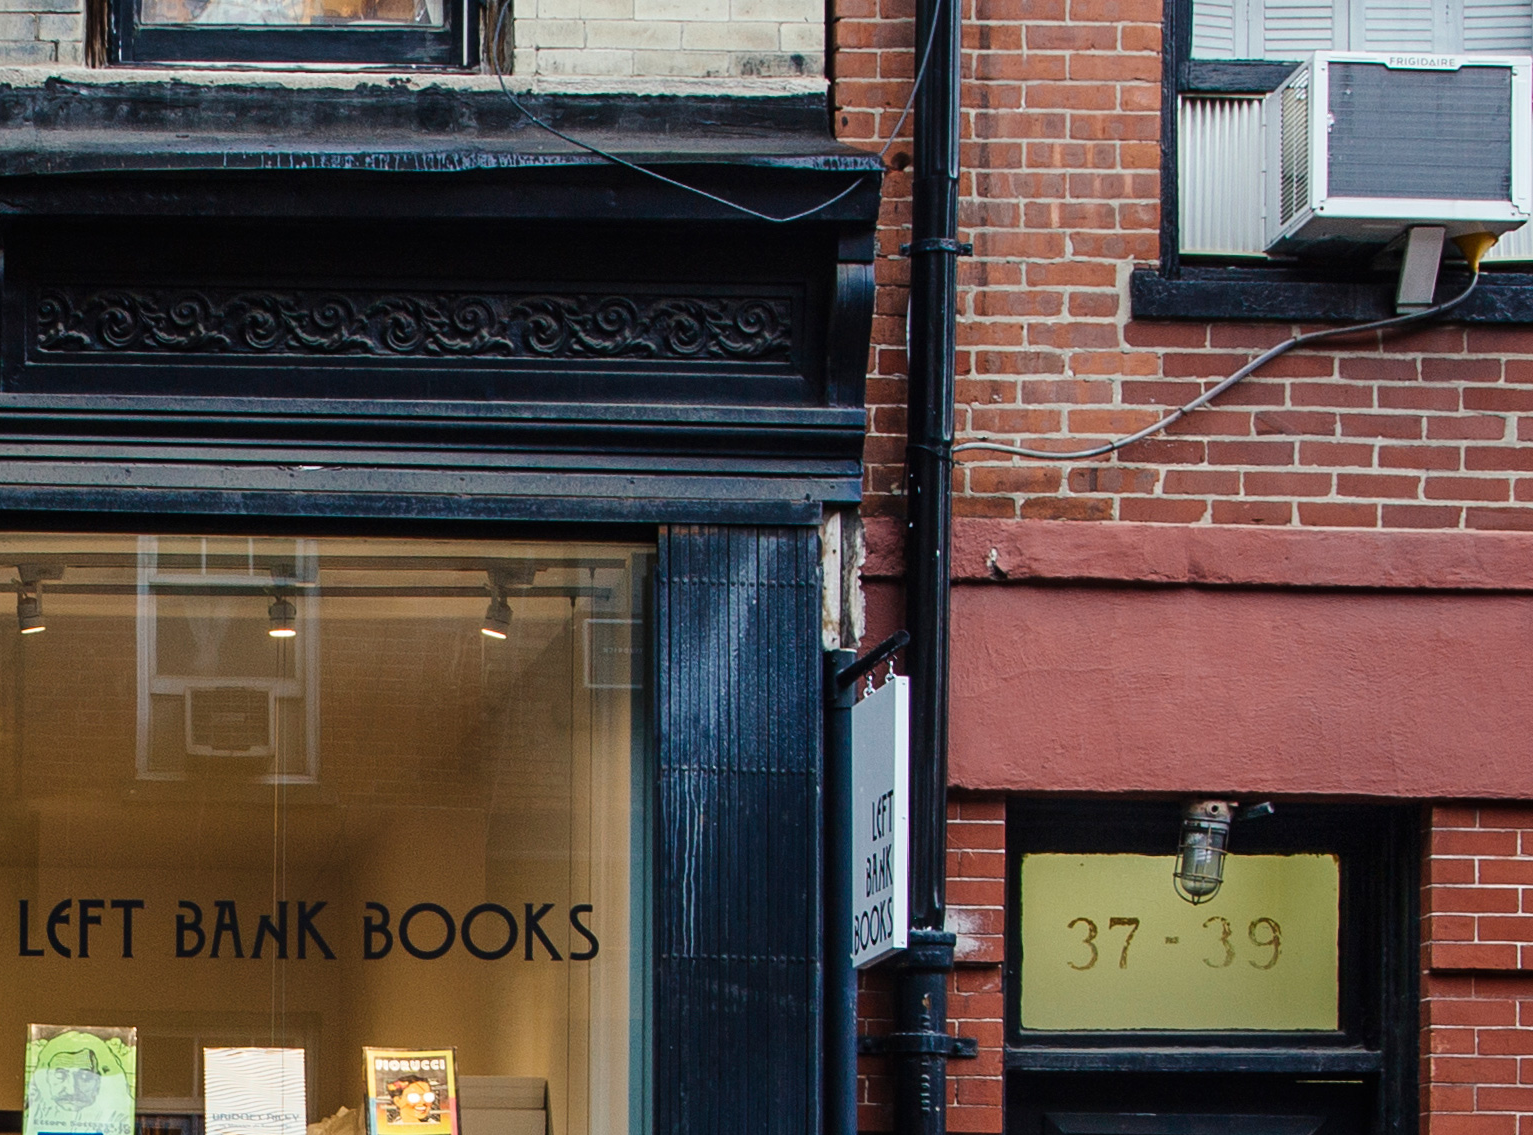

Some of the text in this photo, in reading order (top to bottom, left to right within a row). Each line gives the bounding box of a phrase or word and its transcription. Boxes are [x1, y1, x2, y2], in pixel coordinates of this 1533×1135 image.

[1388, 56, 1457, 68] FRIGIDAIRE
[871, 789, 895, 842] LEFT
[865, 848, 893, 898] BANK
[19, 898, 601, 962] LEFT BANK BOOKS
[853, 900, 894, 956] BOOKS
[374, 1058, 446, 1071] FIORUCCI
